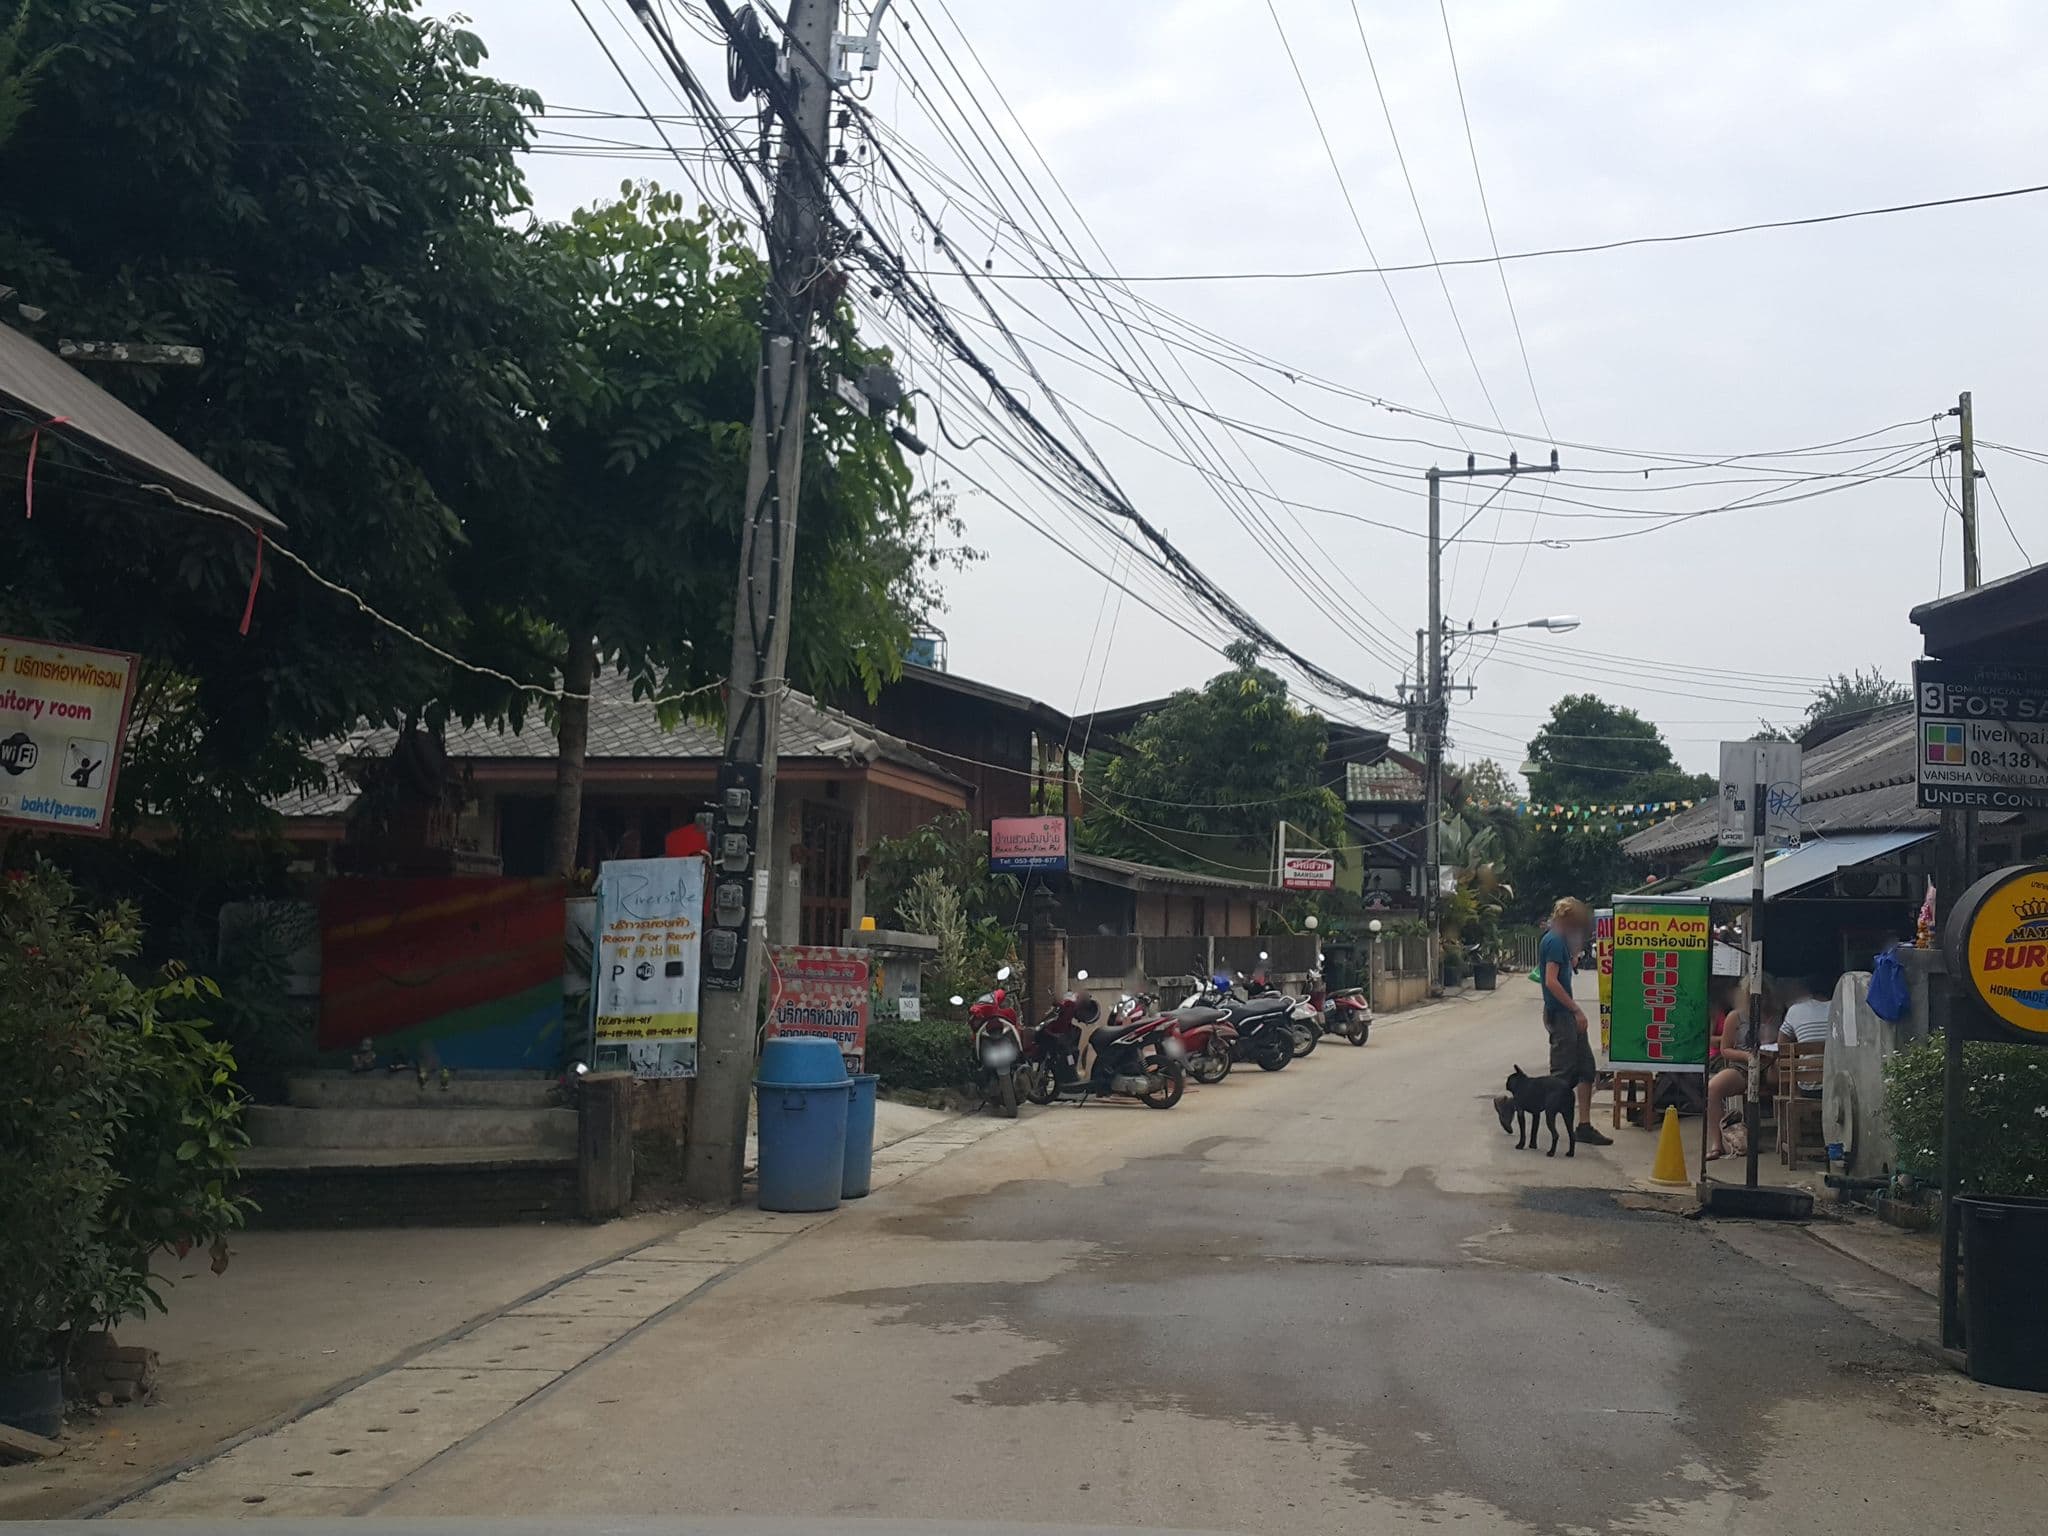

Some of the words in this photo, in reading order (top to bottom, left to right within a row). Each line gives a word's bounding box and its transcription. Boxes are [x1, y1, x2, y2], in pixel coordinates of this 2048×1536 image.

[1925, 686, 1942, 710] 3
[1949, 695, 2008, 717] FOR
[49, 701, 92, 720] room
[1924, 770, 1972, 781] VANISHA
[20, 796, 97, 820] baht/person
[1617, 916, 1660, 931] Baan
[1667, 917, 1706, 932] Aom
[602, 934, 636, 944] Room
[639, 932, 662, 943] For
[665, 930, 697, 942] Rent
[1984, 945, 2048, 971] BUR
[1989, 983, 2045, 1004] HOMEMADE
[1642, 951, 1679, 1060] HOSTEL
[832, 1031, 858, 1042] RENT
